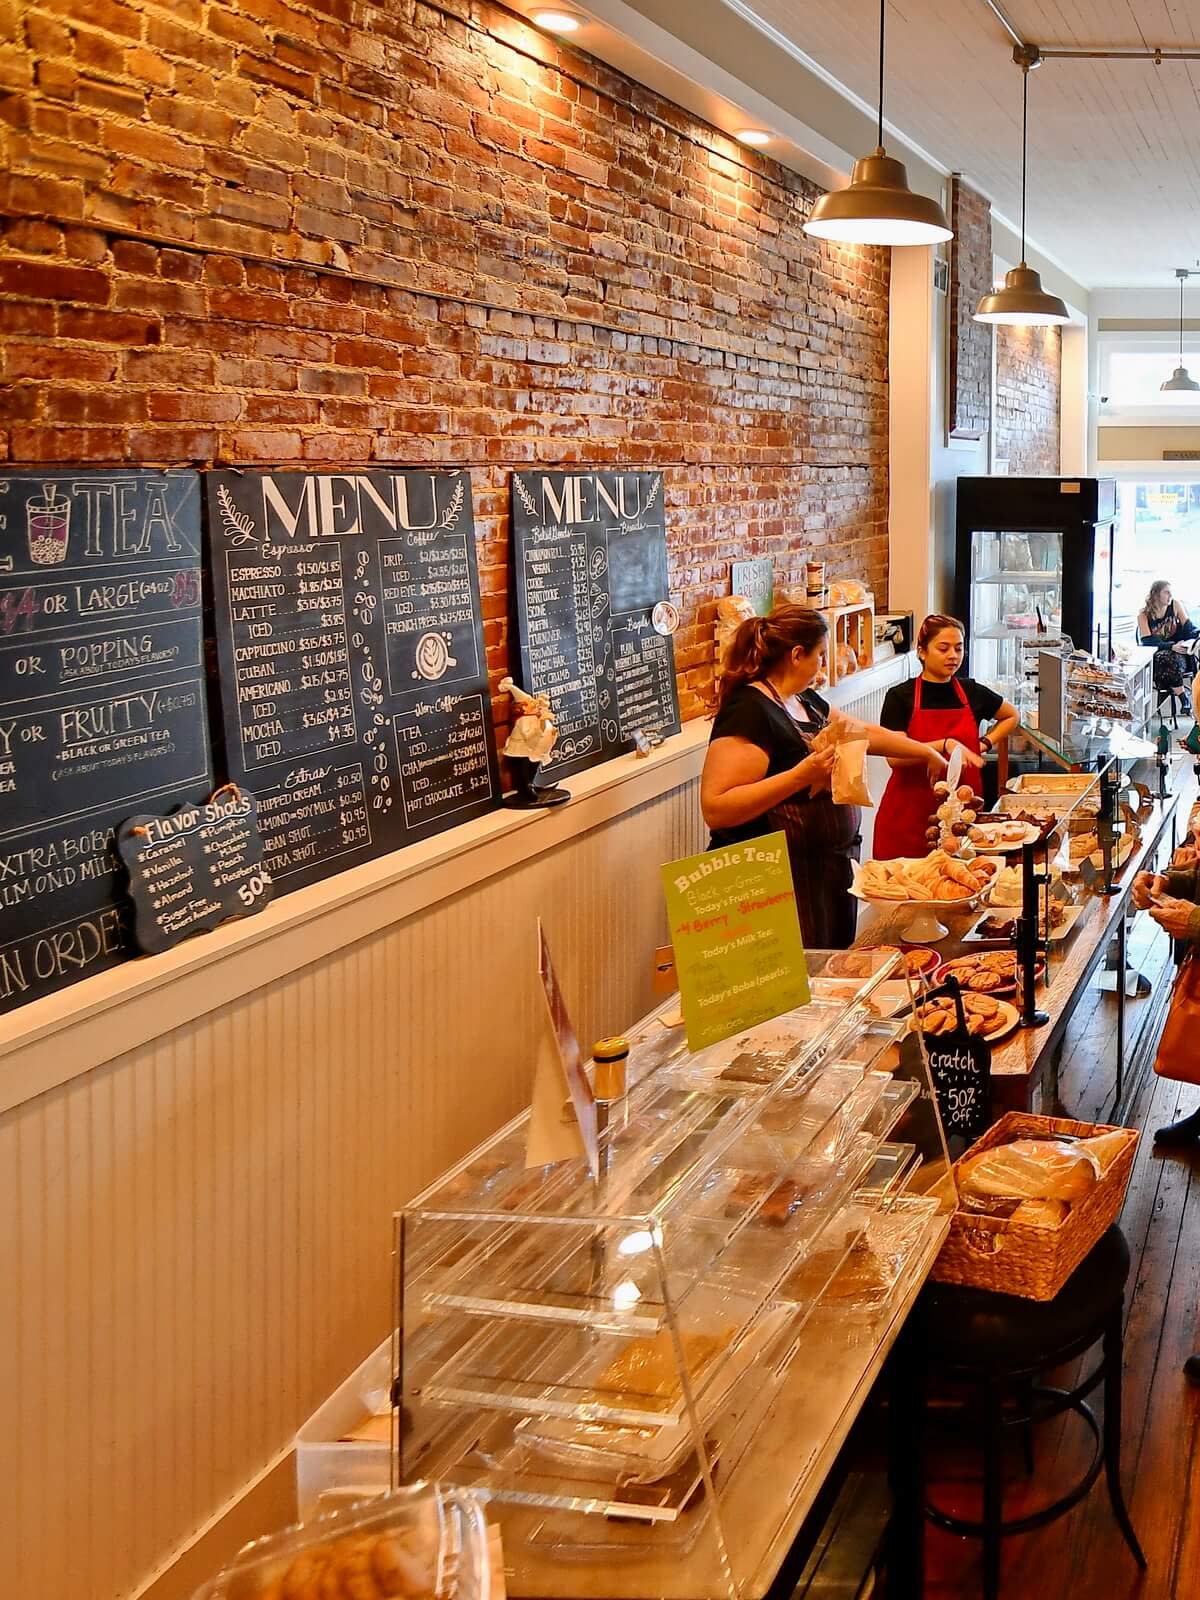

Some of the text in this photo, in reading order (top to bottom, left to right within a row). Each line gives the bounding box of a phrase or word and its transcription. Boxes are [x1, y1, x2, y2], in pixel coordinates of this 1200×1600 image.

[261, 475, 438, 541] MENU
[542, 476, 641, 526] MENU
[72, 482, 182, 557] TEA
[407, 531, 439, 546] Coffee
[262, 543, 316, 560] Espresso
[383, 554, 403, 567] DRIP
[231, 566, 281, 581] ESPRESSO
[392, 570, 410, 582] ICED
[532, 562, 551, 575] VEGAN
[44, 594, 70, 614] OR
[76, 581, 140, 612] LARGE
[231, 584, 285, 601] MACCHIATO
[384, 584, 416, 600] RED EYE
[232, 604, 277, 620] LATTE
[395, 602, 413, 615] ICED
[528, 603, 546, 618] SCONE
[248, 622, 273, 639] ICED
[387, 618, 418, 634] FRENCH
[15, 635, 153, 675] OR POPPING
[236, 640, 296, 661] CAPPUCCINO
[238, 661, 275, 681] CUBAN
[531, 654, 566, 673] MAGIC BAR
[532, 673, 547, 689] NYC
[547, 668, 570, 684] CRUMB
[240, 680, 291, 703] AMERICANO
[20, 725, 47, 742] OR
[60, 691, 159, 744] FRUITY
[253, 702, 276, 719] ICED
[243, 720, 284, 743] MOCHA
[398, 725, 422, 741] TEA
[0, 761, 16, 775] EA
[98, 743, 112, 753] OR
[112, 734, 149, 751] GREEN
[150, 729, 171, 742] TEA
[256, 741, 281, 760] ICED
[408, 742, 428, 757] ICED
[284, 765, 332, 788] Extras
[402, 759, 422, 777] CHAI
[0, 780, 16, 793] EA
[293, 783, 322, 801] CREAM
[337, 772, 361, 788] $0.50
[413, 777, 430, 792] ICED
[297, 805, 313, 820] SOY
[314, 799, 336, 816] MILK
[339, 791, 362, 807] $0.50
[407, 797, 423, 813] HOT
[424, 783, 464, 806] CHOCOLATE
[144, 795, 250, 843] Flavor Shots
[207, 818, 246, 837] Pumpkin
[262, 807, 366, 852] UBAN SHOT $0.95
[145, 838, 186, 860] Caramel
[211, 830, 251, 851] Chocolate
[219, 842, 247, 858] Milano
[263, 825, 367, 871] XTRA SHOT $0.95
[0, 828, 116, 881] XTRA BOBA
[218, 854, 245, 871] Peach
[150, 856, 184, 876] Vanilla
[221, 861, 262, 884] Raspberry
[674, 847, 782, 894] Bubble Tea!
[0, 867, 76, 909] LMOND
[156, 866, 194, 891] Hazelnut
[161, 882, 193, 906] Almond
[162, 897, 208, 924] Sugar Free
[694, 898, 729, 916] Today's
[729, 894, 750, 906] Fruit
[694, 913, 728, 932] Berry
[702, 941, 736, 959] Today's
[736, 934, 756, 948] Milk
[698, 989, 732, 1008] Today's
[732, 980, 756, 994] Boba
[926, 1048, 980, 1074] cratch
[948, 1087, 976, 1111] 50%
